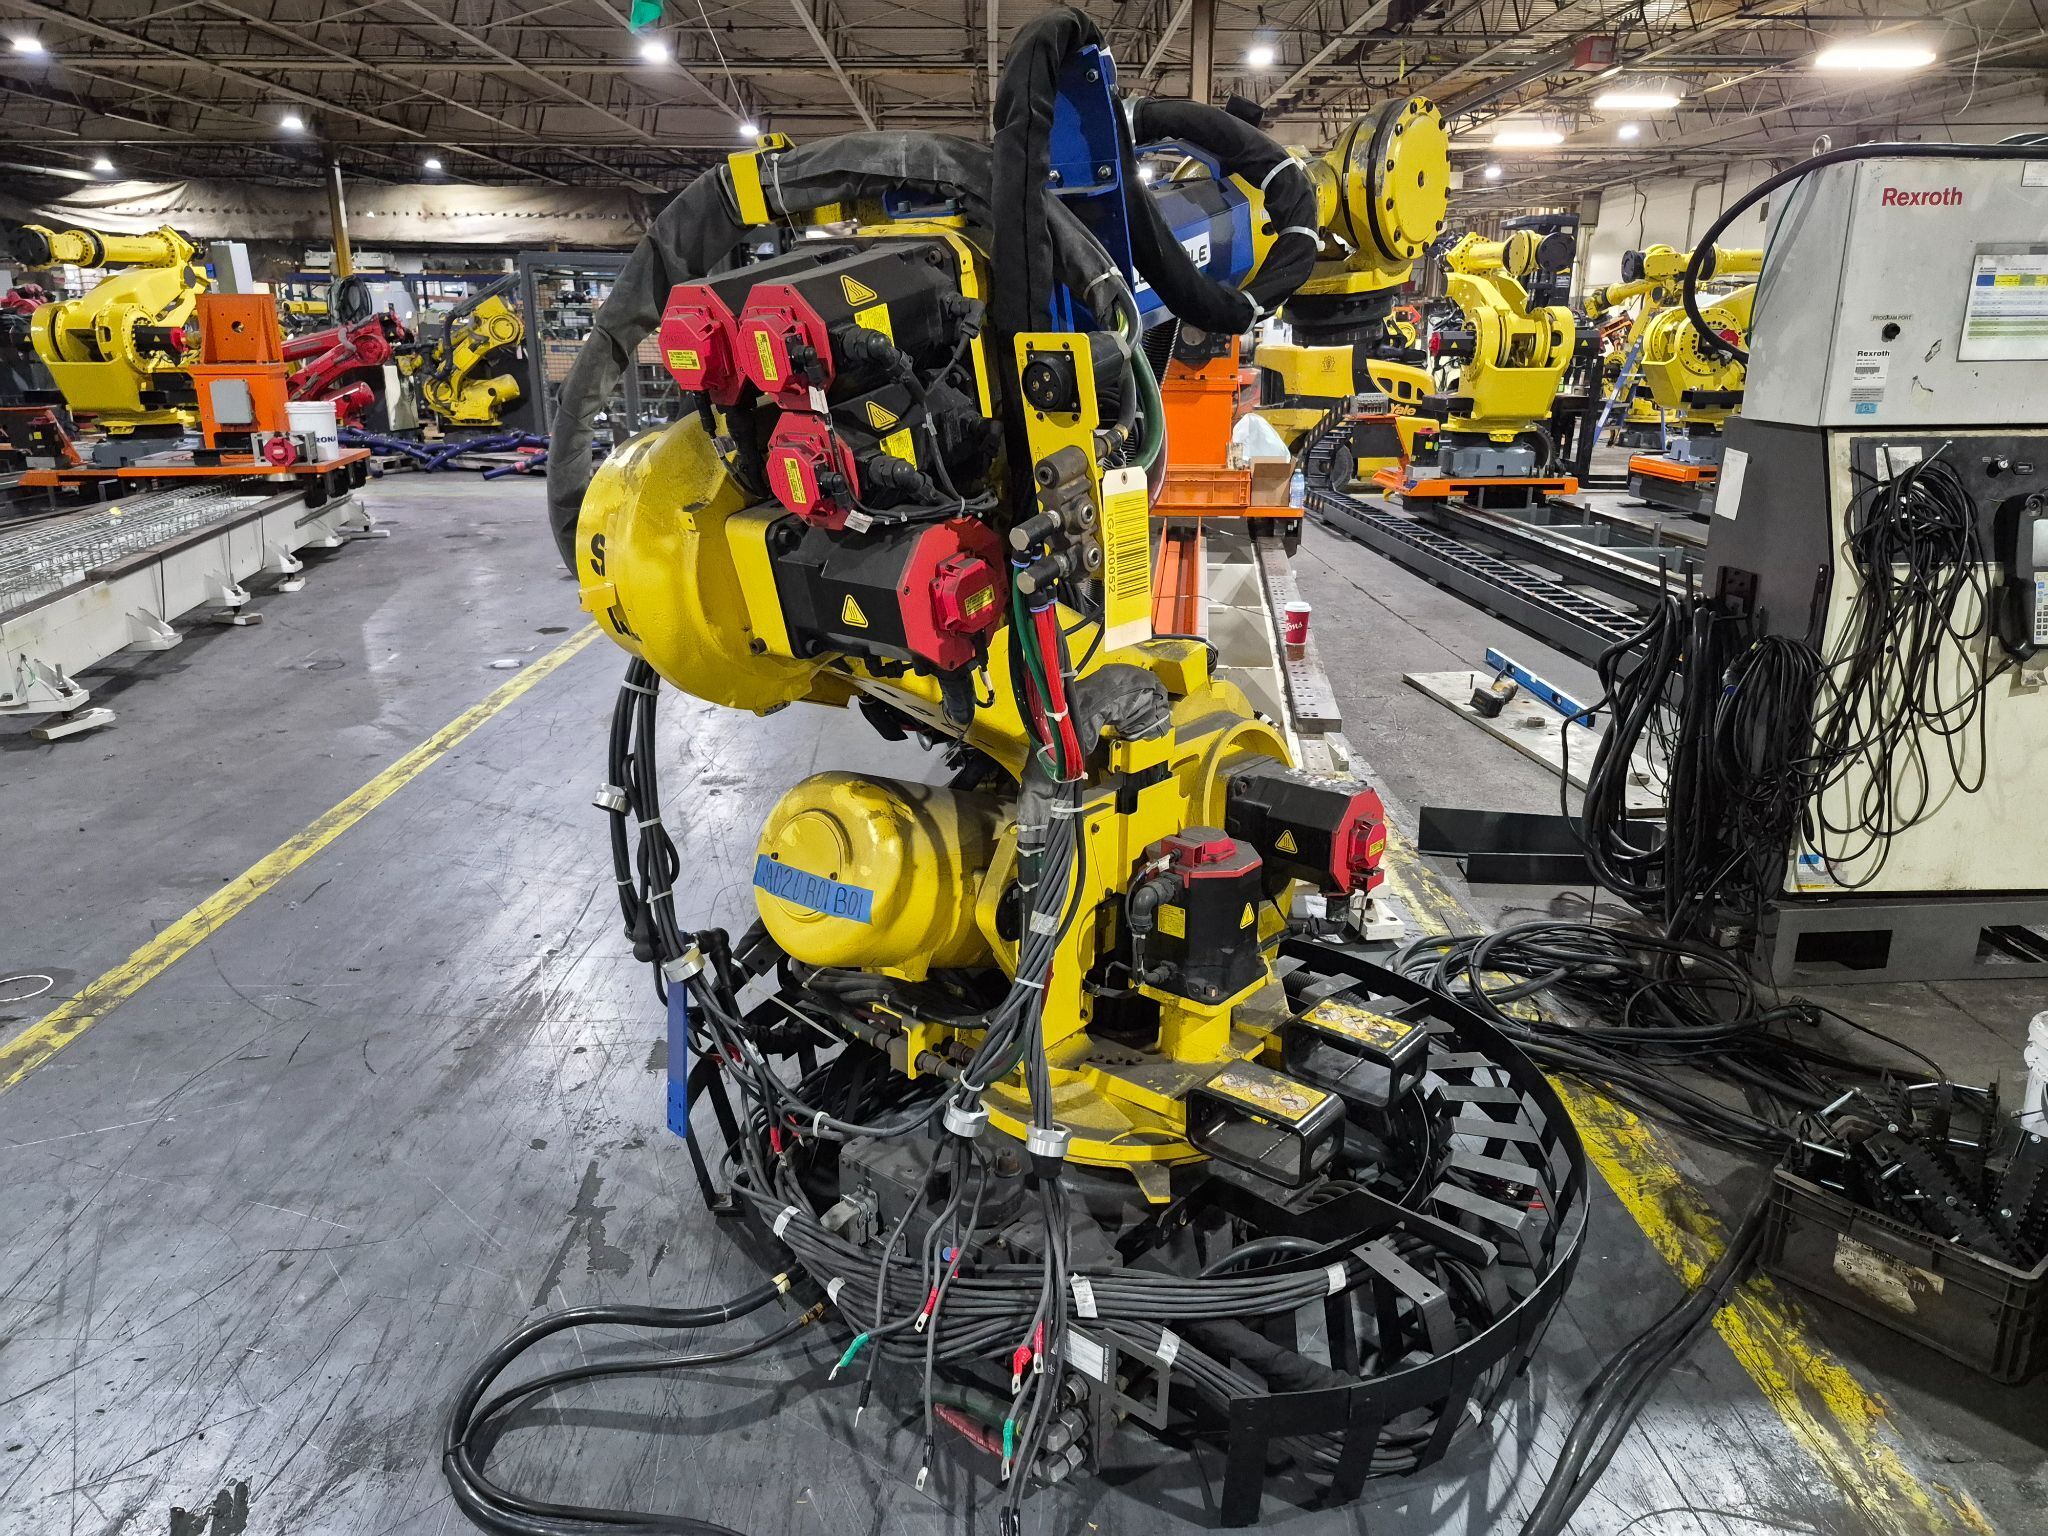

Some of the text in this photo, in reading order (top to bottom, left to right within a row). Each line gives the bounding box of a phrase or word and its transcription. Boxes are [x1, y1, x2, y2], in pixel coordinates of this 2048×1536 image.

[1881, 186, 1963, 207] Rexroth
[1390, 403, 1417, 416] Yale
[1107, 513, 1117, 594] IGAM0052
